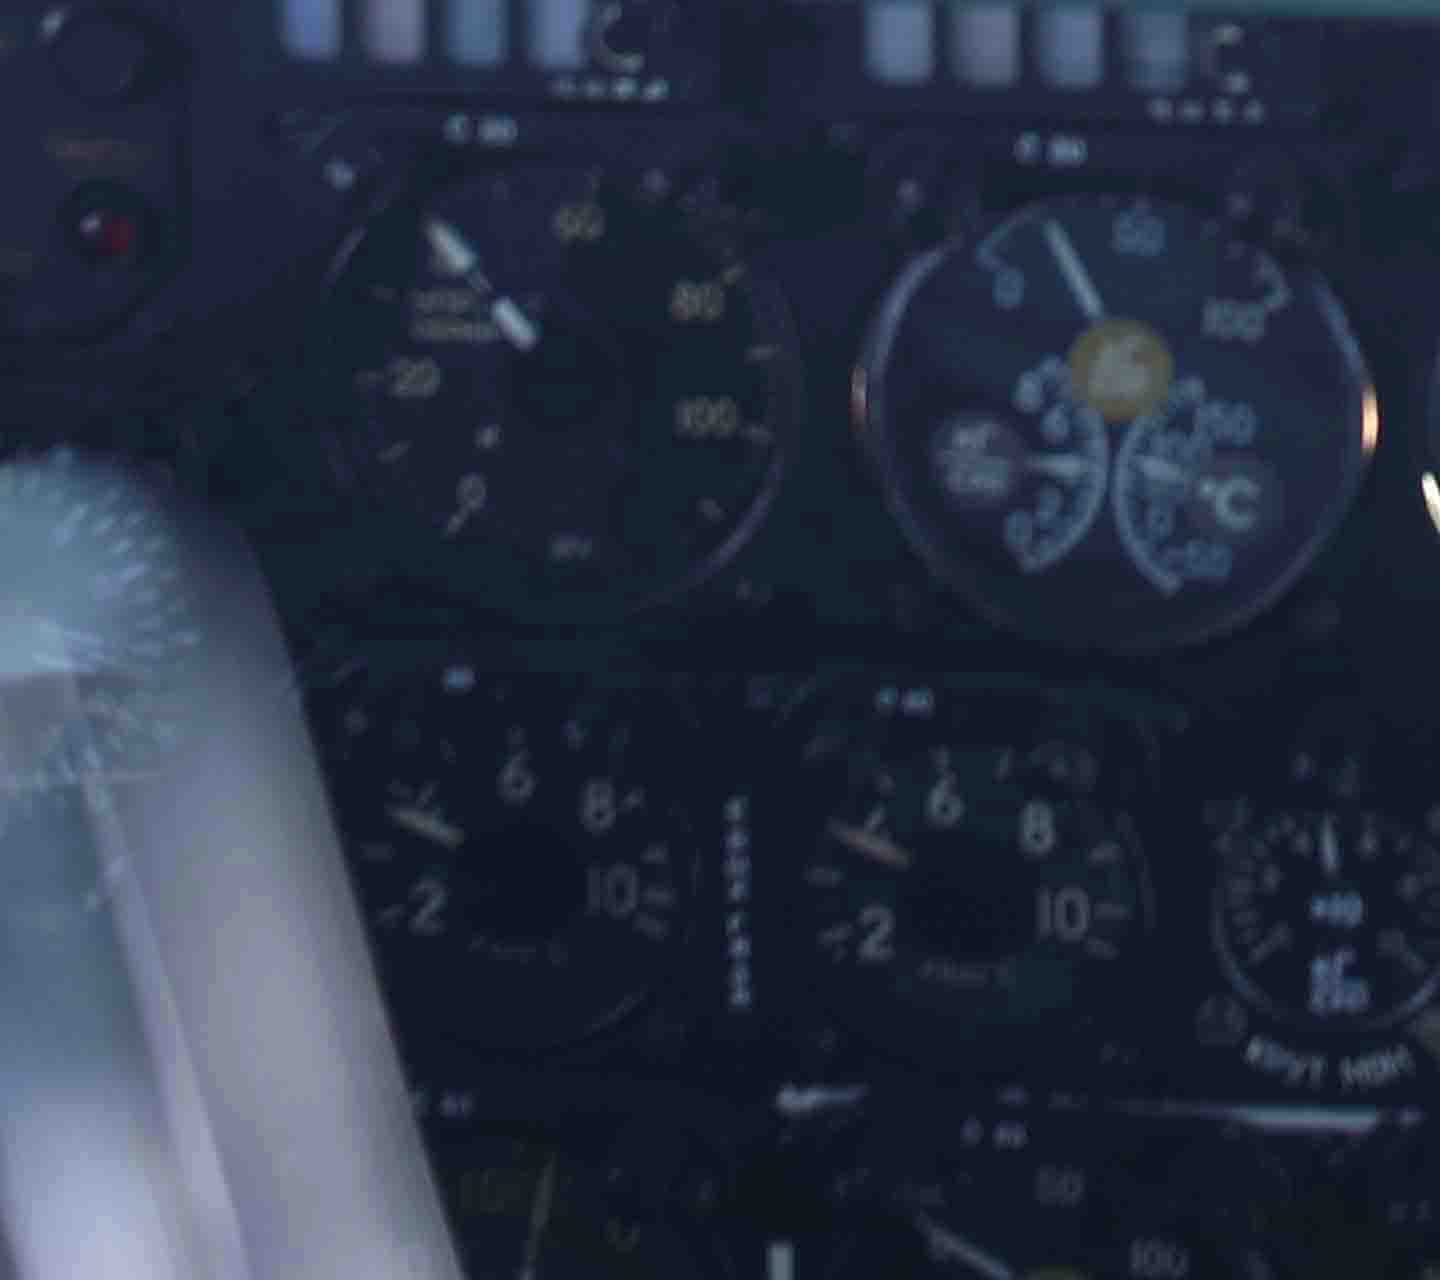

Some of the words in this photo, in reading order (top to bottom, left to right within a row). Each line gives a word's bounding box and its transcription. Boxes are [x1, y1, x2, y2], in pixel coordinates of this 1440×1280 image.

[496, 751, 536, 805] 6
[579, 778, 619, 834] 8
[923, 771, 967, 829] 6
[1016, 799, 1057, 859] 8
[408, 877, 450, 936] 2
[586, 863, 639, 919] 10
[1036, 885, 1092, 942] 10
[855, 905, 897, 964] 2
